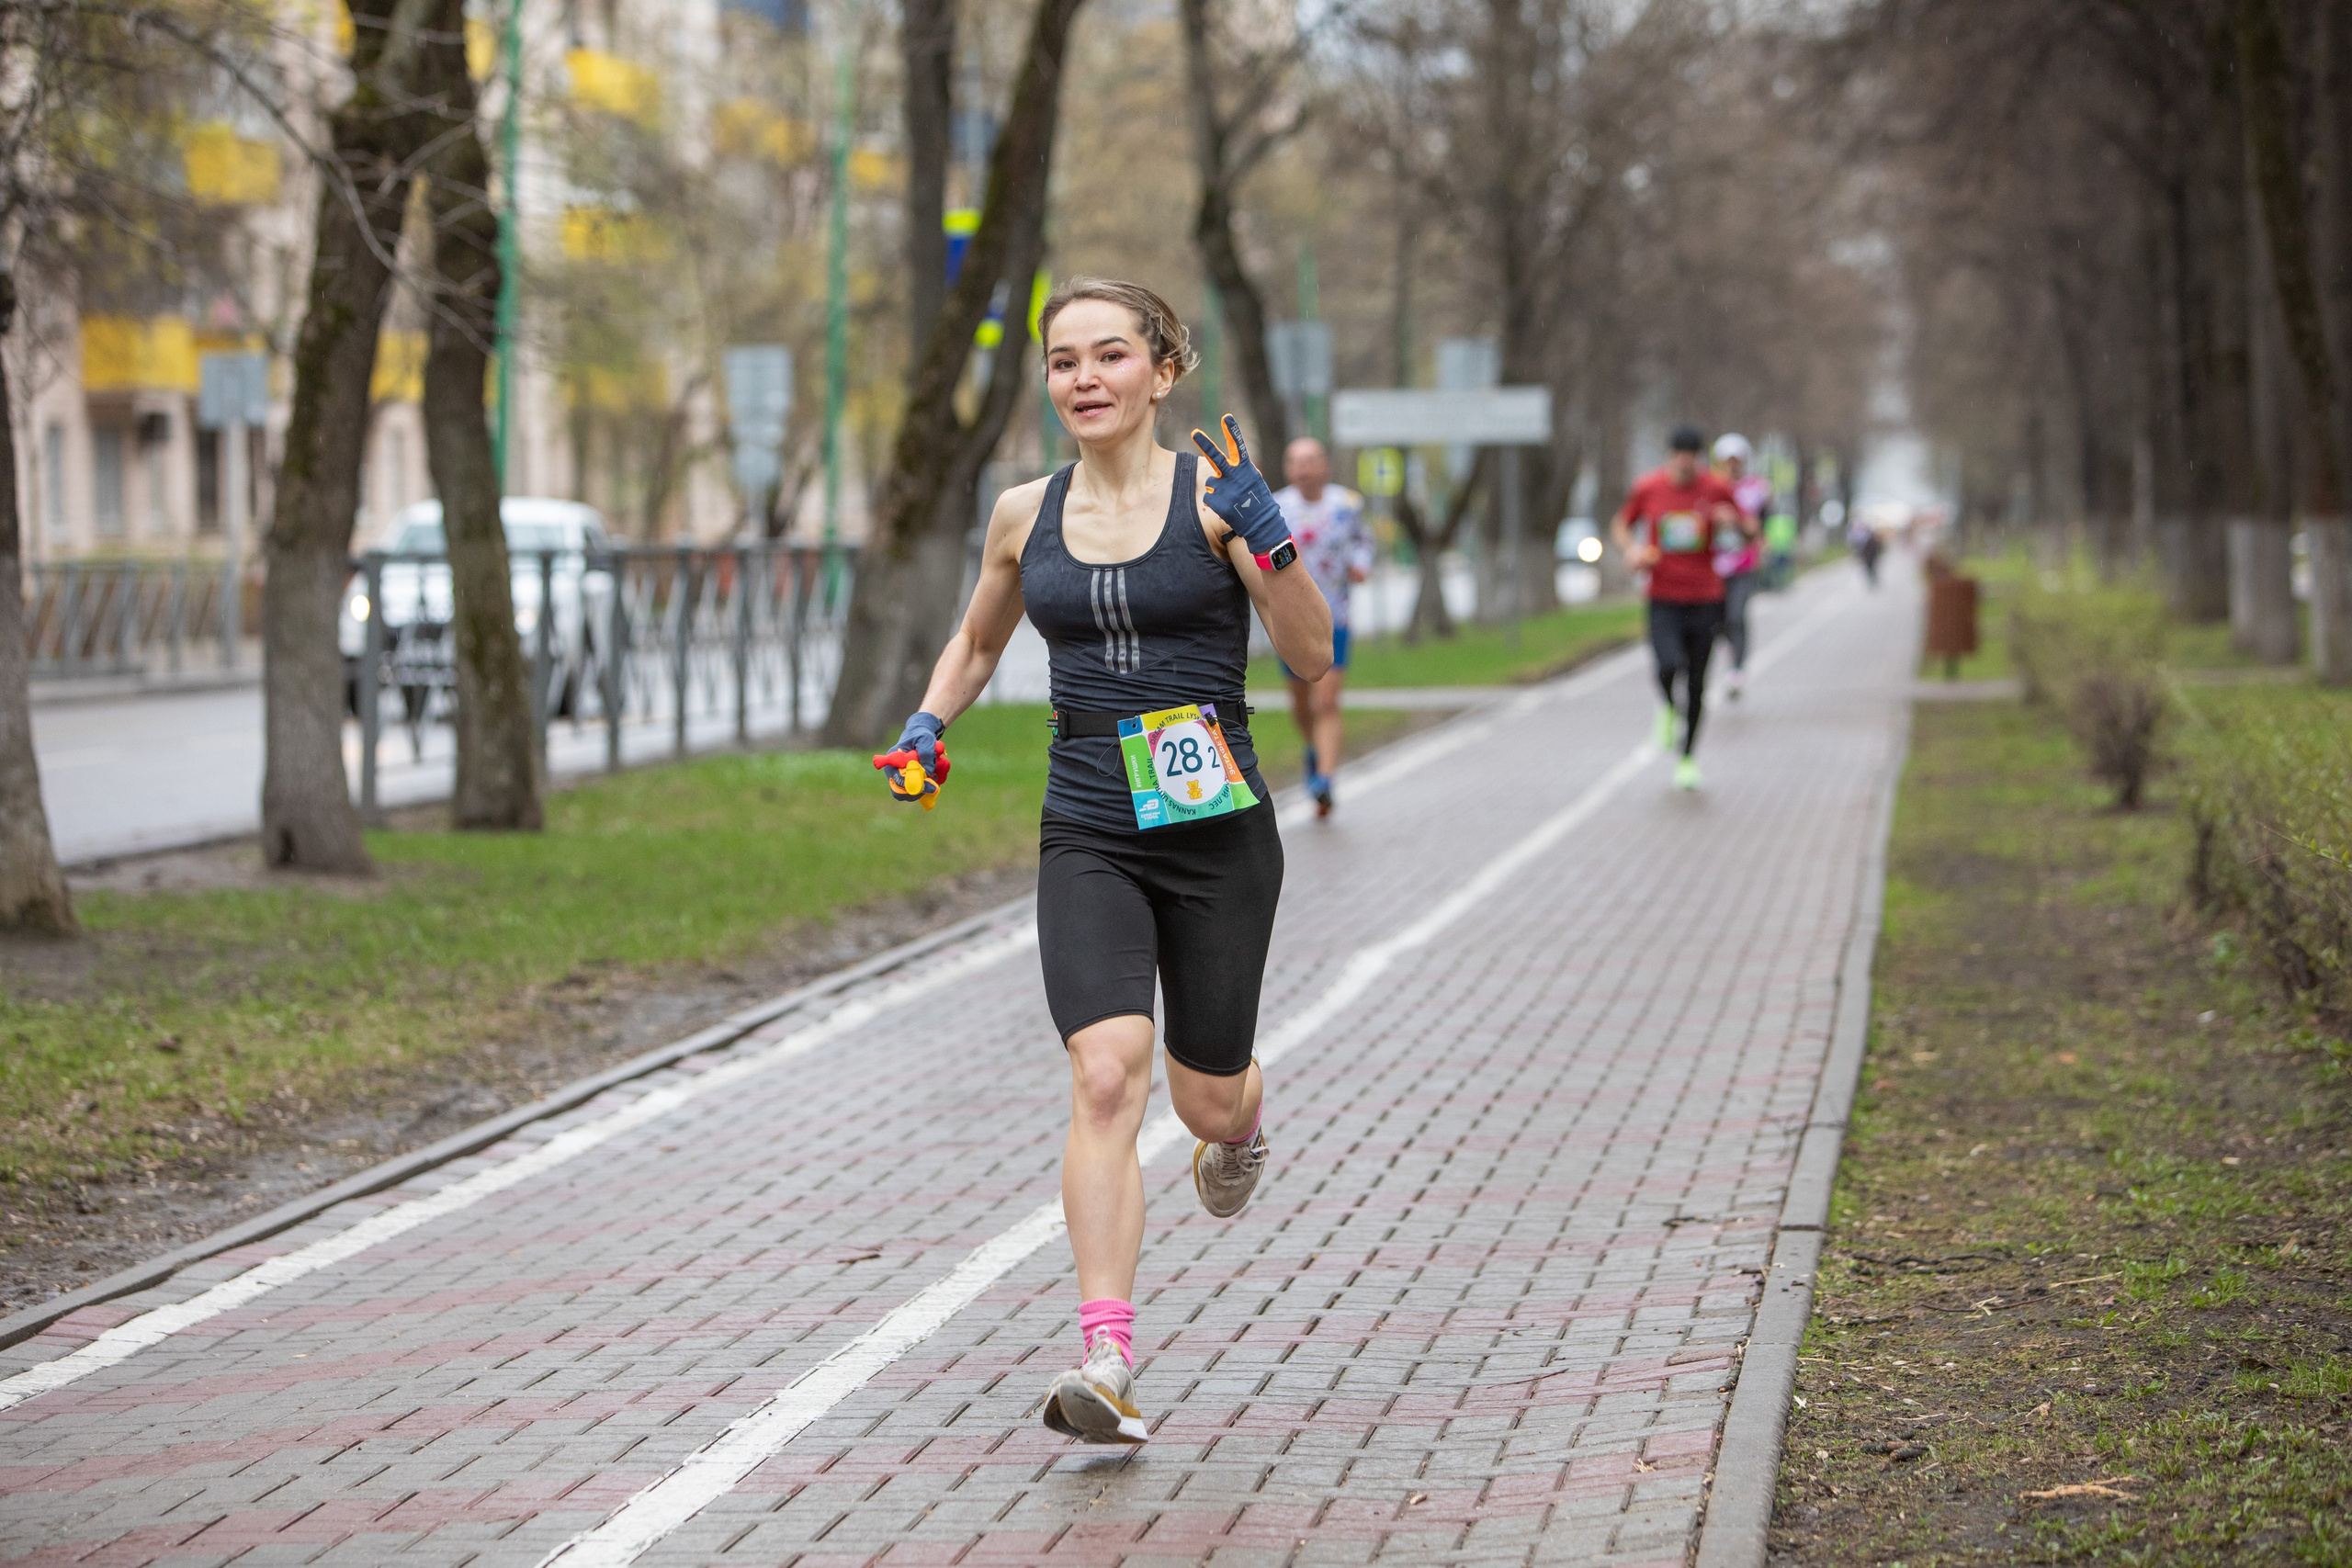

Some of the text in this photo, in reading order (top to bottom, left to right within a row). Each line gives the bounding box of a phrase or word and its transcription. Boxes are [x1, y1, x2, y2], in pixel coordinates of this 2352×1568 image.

[1149, 720, 1166, 745] DREAM
[1165, 712, 1185, 724] TRAIL
[1161, 738, 1221, 777] 28 2
[1211, 728, 1236, 775] ЭСТАФЕТА
[1147, 757, 1156, 779] TRAIL
[1168, 800, 1197, 816] KANNAS
[1208, 795, 1223, 810] ЛЕС
